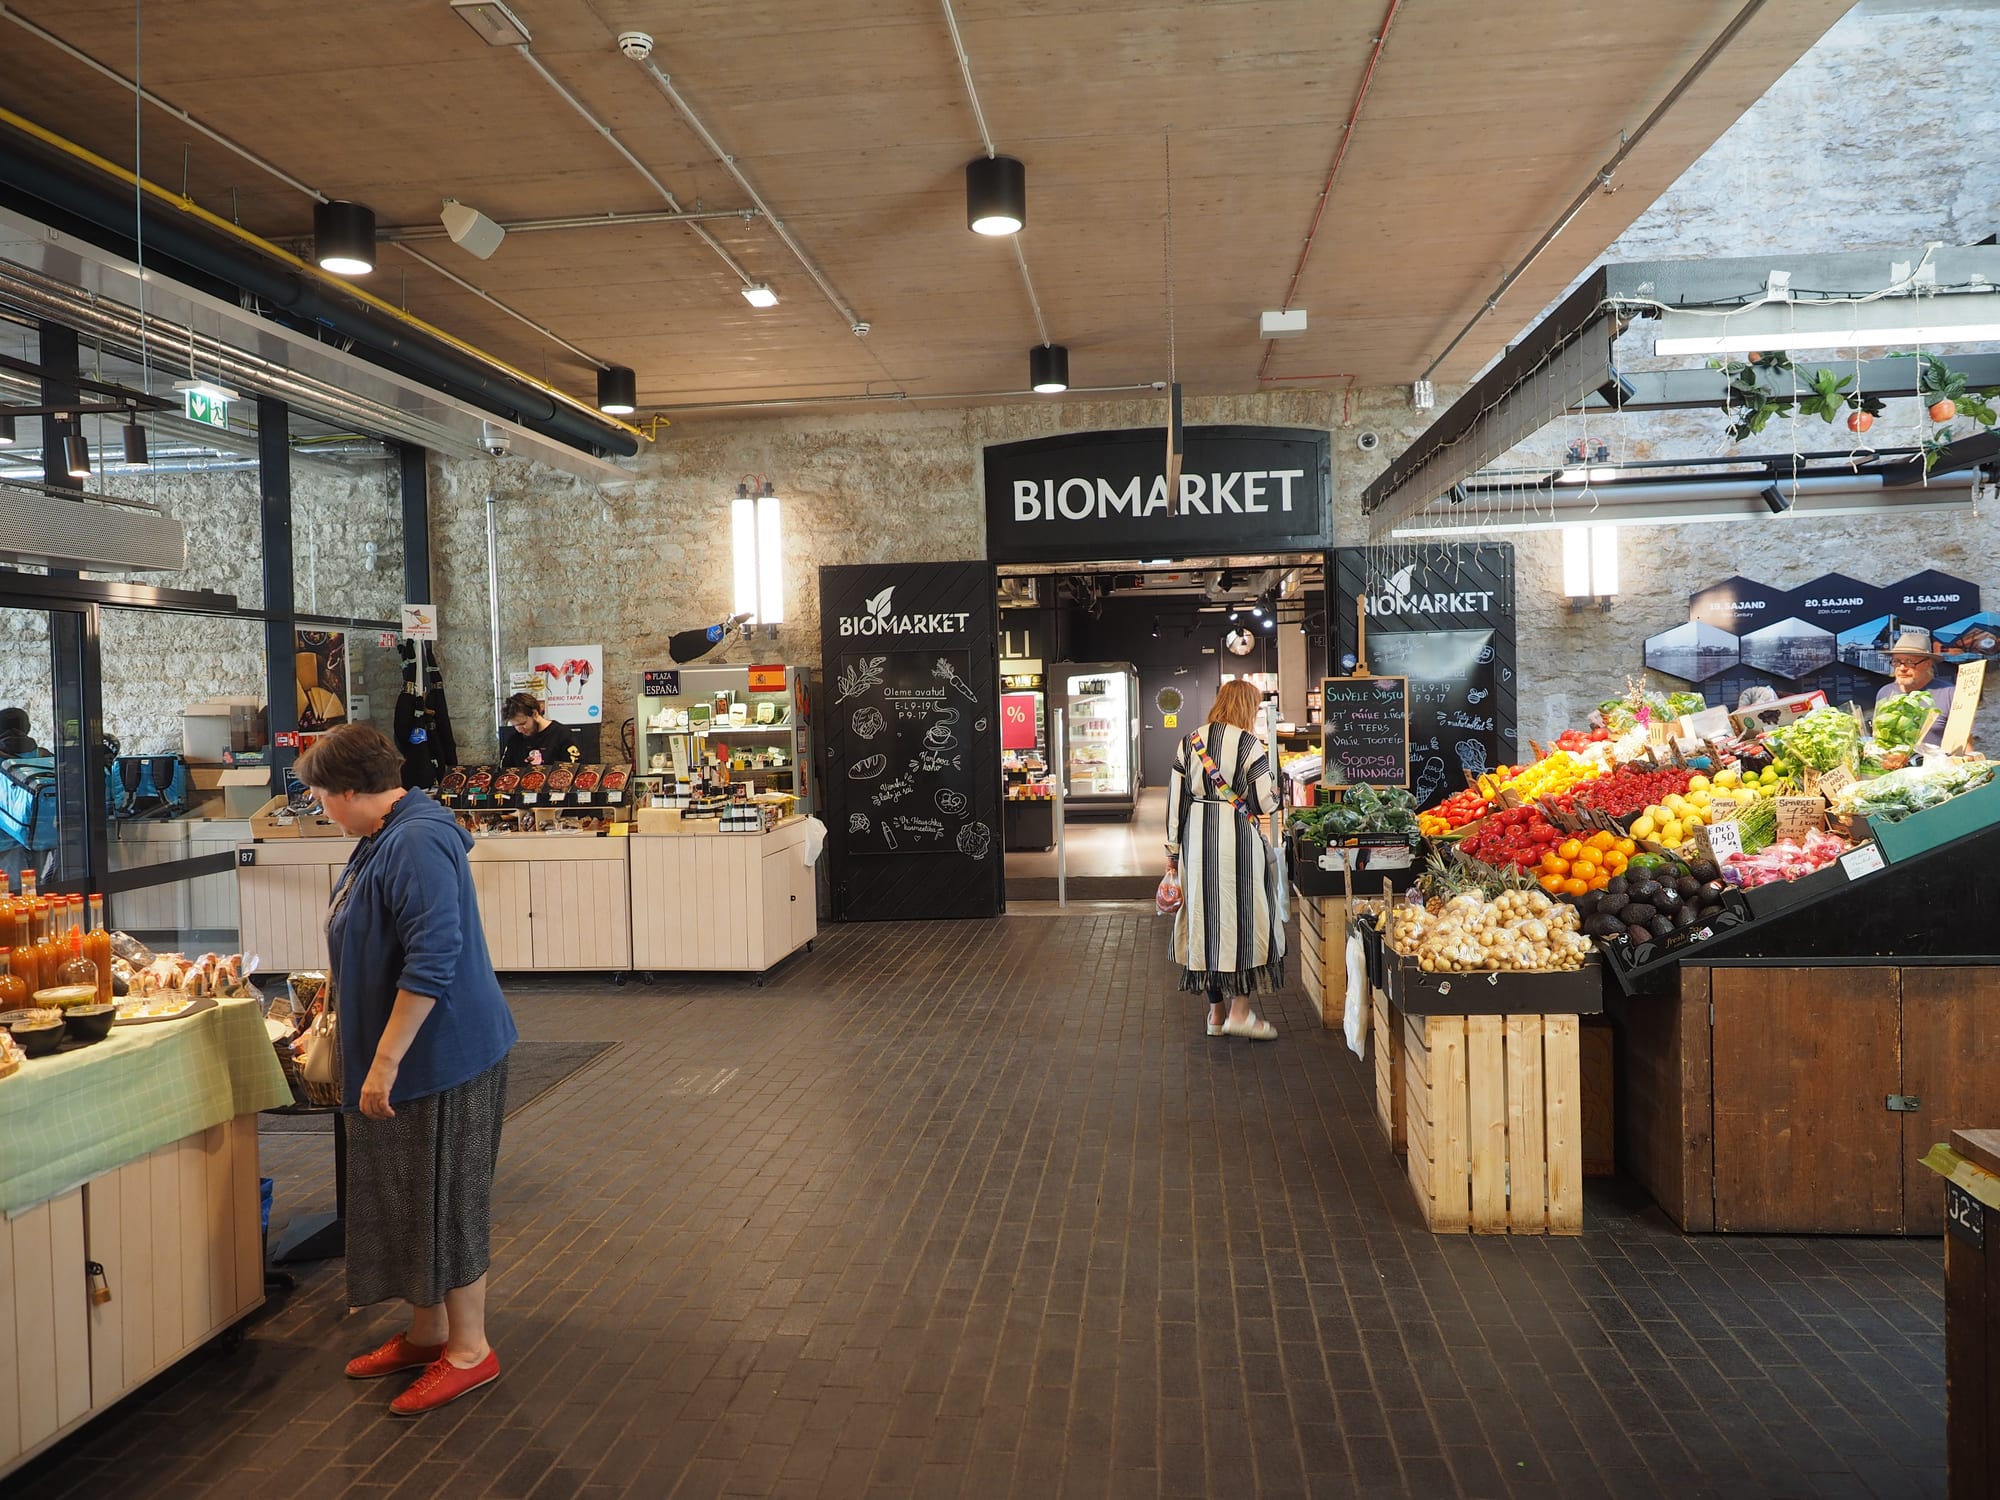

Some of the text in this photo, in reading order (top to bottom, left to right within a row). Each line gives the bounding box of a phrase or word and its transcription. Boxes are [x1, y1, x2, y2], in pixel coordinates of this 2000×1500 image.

[1013, 469, 1304, 522] BIOMARKET
[1804, 597, 1864, 607] 20. SAJAND
[1917, 594, 1961, 603] SAJAND
[839, 612, 970, 636] BIOMARKET
[999, 630, 1030, 658] LI
[652, 672, 672, 681] PLAZA
[646, 683, 678, 695] ESPAÑA
[883, 686, 945, 697] Oleme avatud
[1415, 694, 1421, 703] P
[898, 711, 905, 719] P
[241, 852, 253, 863] 87
